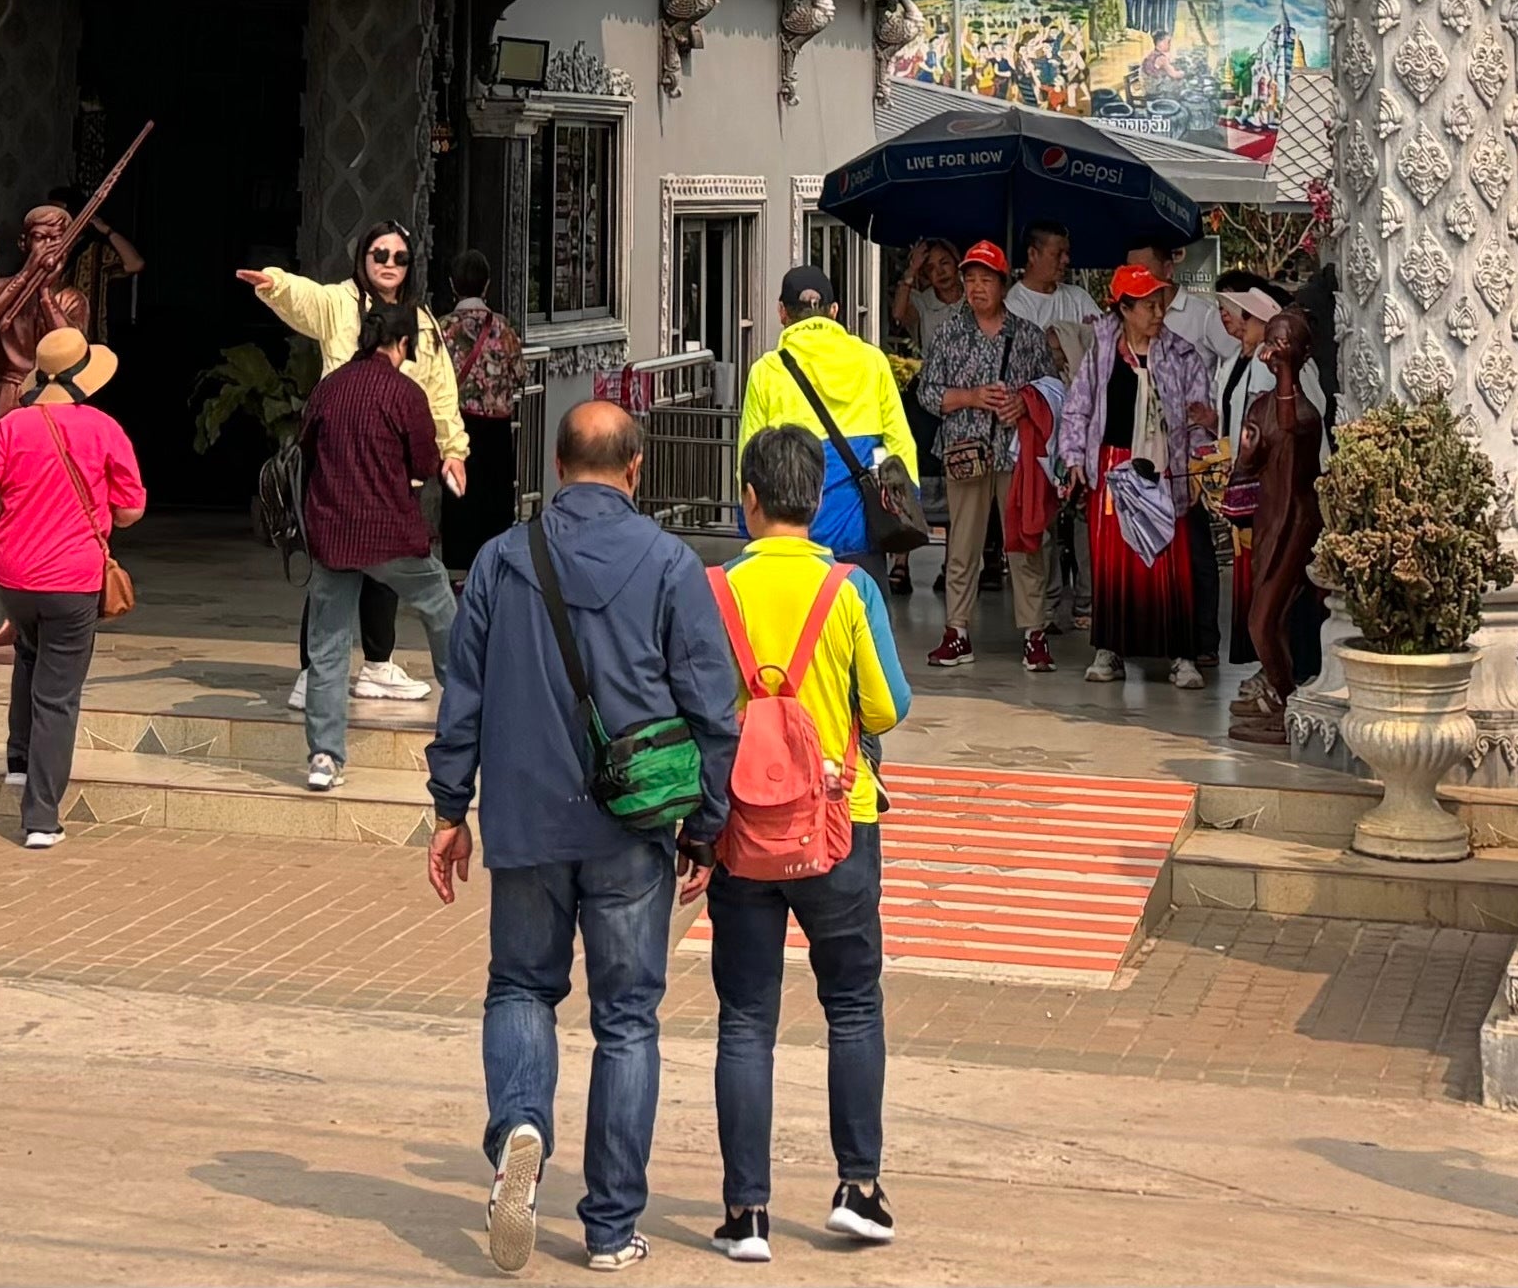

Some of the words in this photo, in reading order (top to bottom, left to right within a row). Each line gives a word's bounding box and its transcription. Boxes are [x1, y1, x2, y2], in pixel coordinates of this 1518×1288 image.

[906, 155, 935, 171] LIVE
[938, 153, 966, 167] FOR
[970, 149, 1003, 166] NOW
[1070, 159, 1125, 184] pepsi
